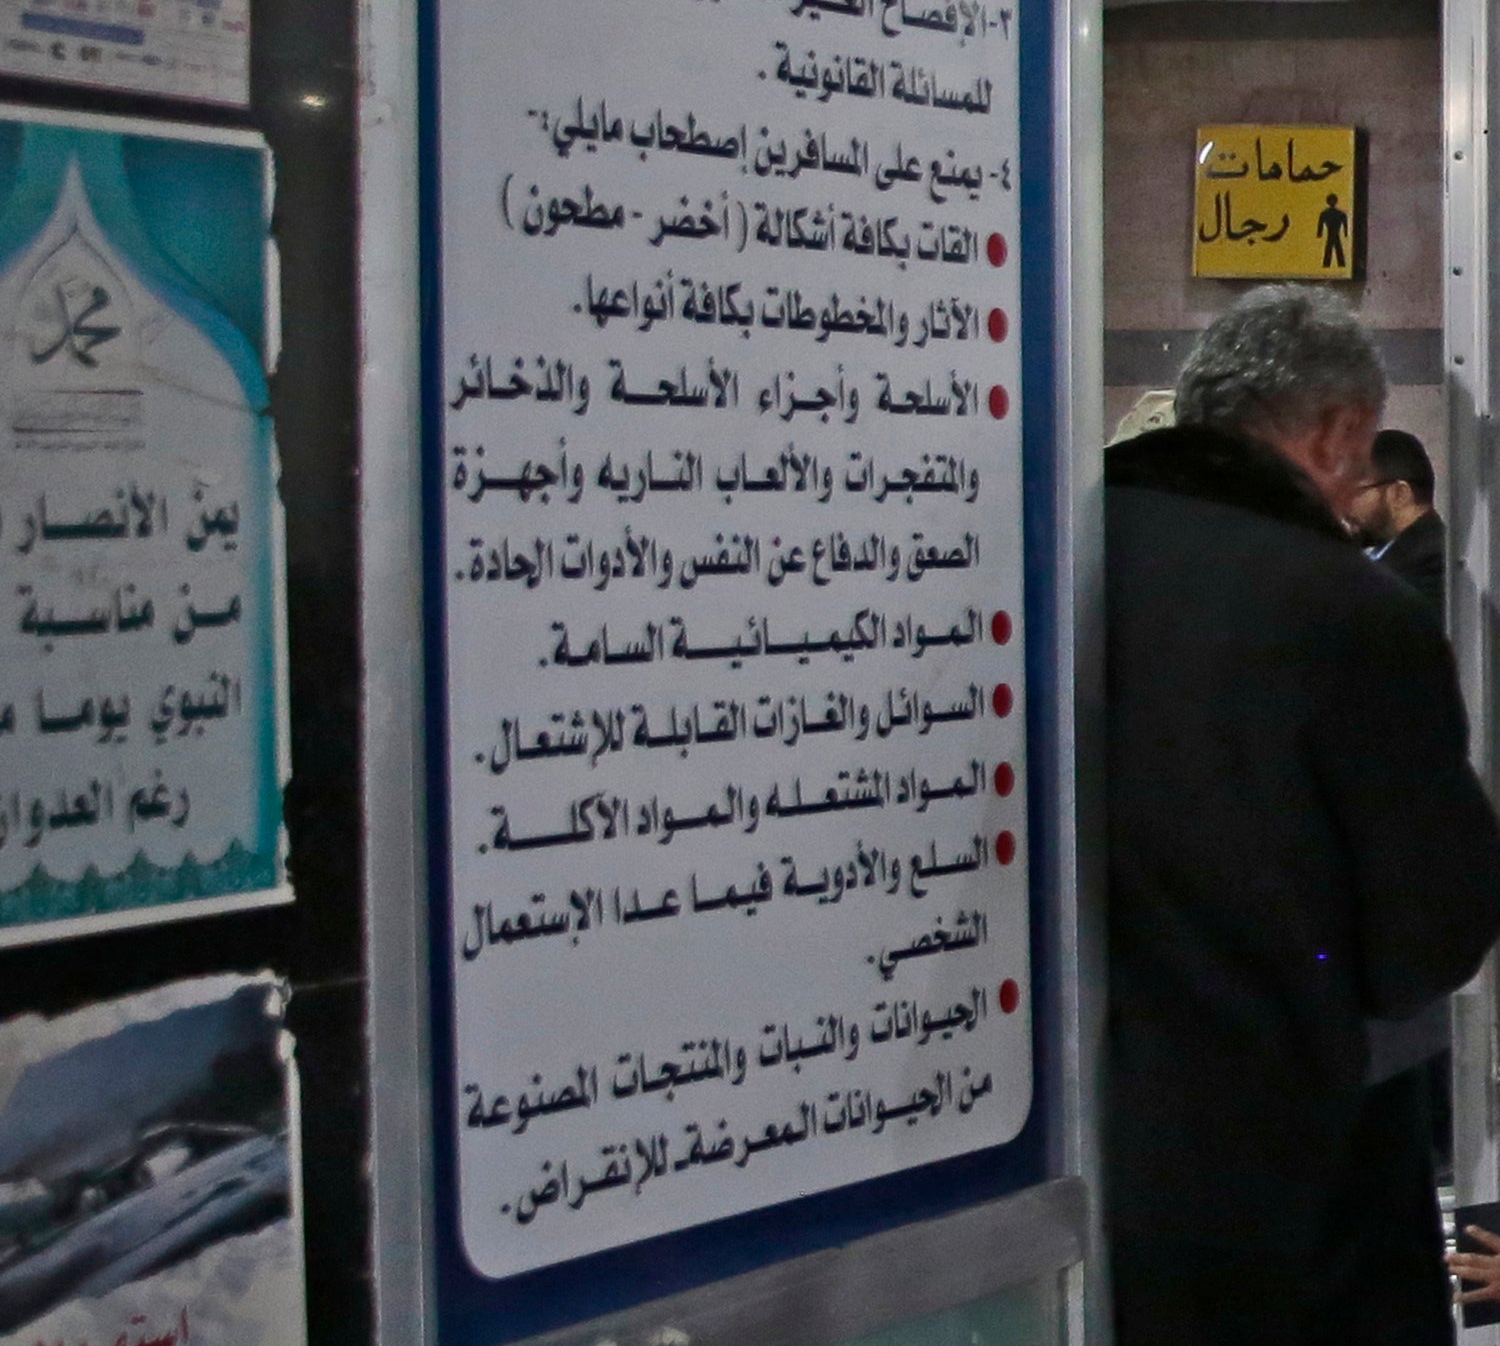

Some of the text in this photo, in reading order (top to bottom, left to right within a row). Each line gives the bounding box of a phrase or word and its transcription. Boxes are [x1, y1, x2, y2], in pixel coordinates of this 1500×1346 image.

[891, 60, 993, 115] للمسائلة
[1203, 136, 1344, 184] حمامات
[1198, 189, 1290, 246] رجال
[573, 269, 979, 349] الآثار والمخطوطات بكافة أنواعها.
[449, 353, 979, 425] الأسلحة وأجزاء الأسلحة والذخائر
[452, 436, 584, 505] وأجهزة
[714, 442, 833, 506] والألعاب
[843, 451, 980, 505] والمتفجرات
[17, 486, 240, 554] يمن الأنصار
[454, 525, 980, 592] الصعق والدفاع عن النفس والأدوات الحادة.
[16, 581, 242, 653] من مناسبة
[538, 607, 983, 670] المواد الكيميائية السامة.
[36, 670, 243, 746] النبوي يوما
[631, 700, 746, 759] القابلة
[751, 691, 870, 747] والغازات
[875, 682, 984, 739] السوائل
[128, 767, 191, 835] رغم
[636, 784, 760, 846] والمواد
[896, 758, 986, 814] المواد
[461, 833, 989, 962] السلع والأدوية فيما عدا الإستعمال
[866, 909, 988, 983] الشخصي.
[464, 986, 987, 1136] الحيوانات والنبات والمنتجات المصنوعة
[957, 1066, 993, 1115] من
[822, 1070, 952, 1135] الحيوانات
